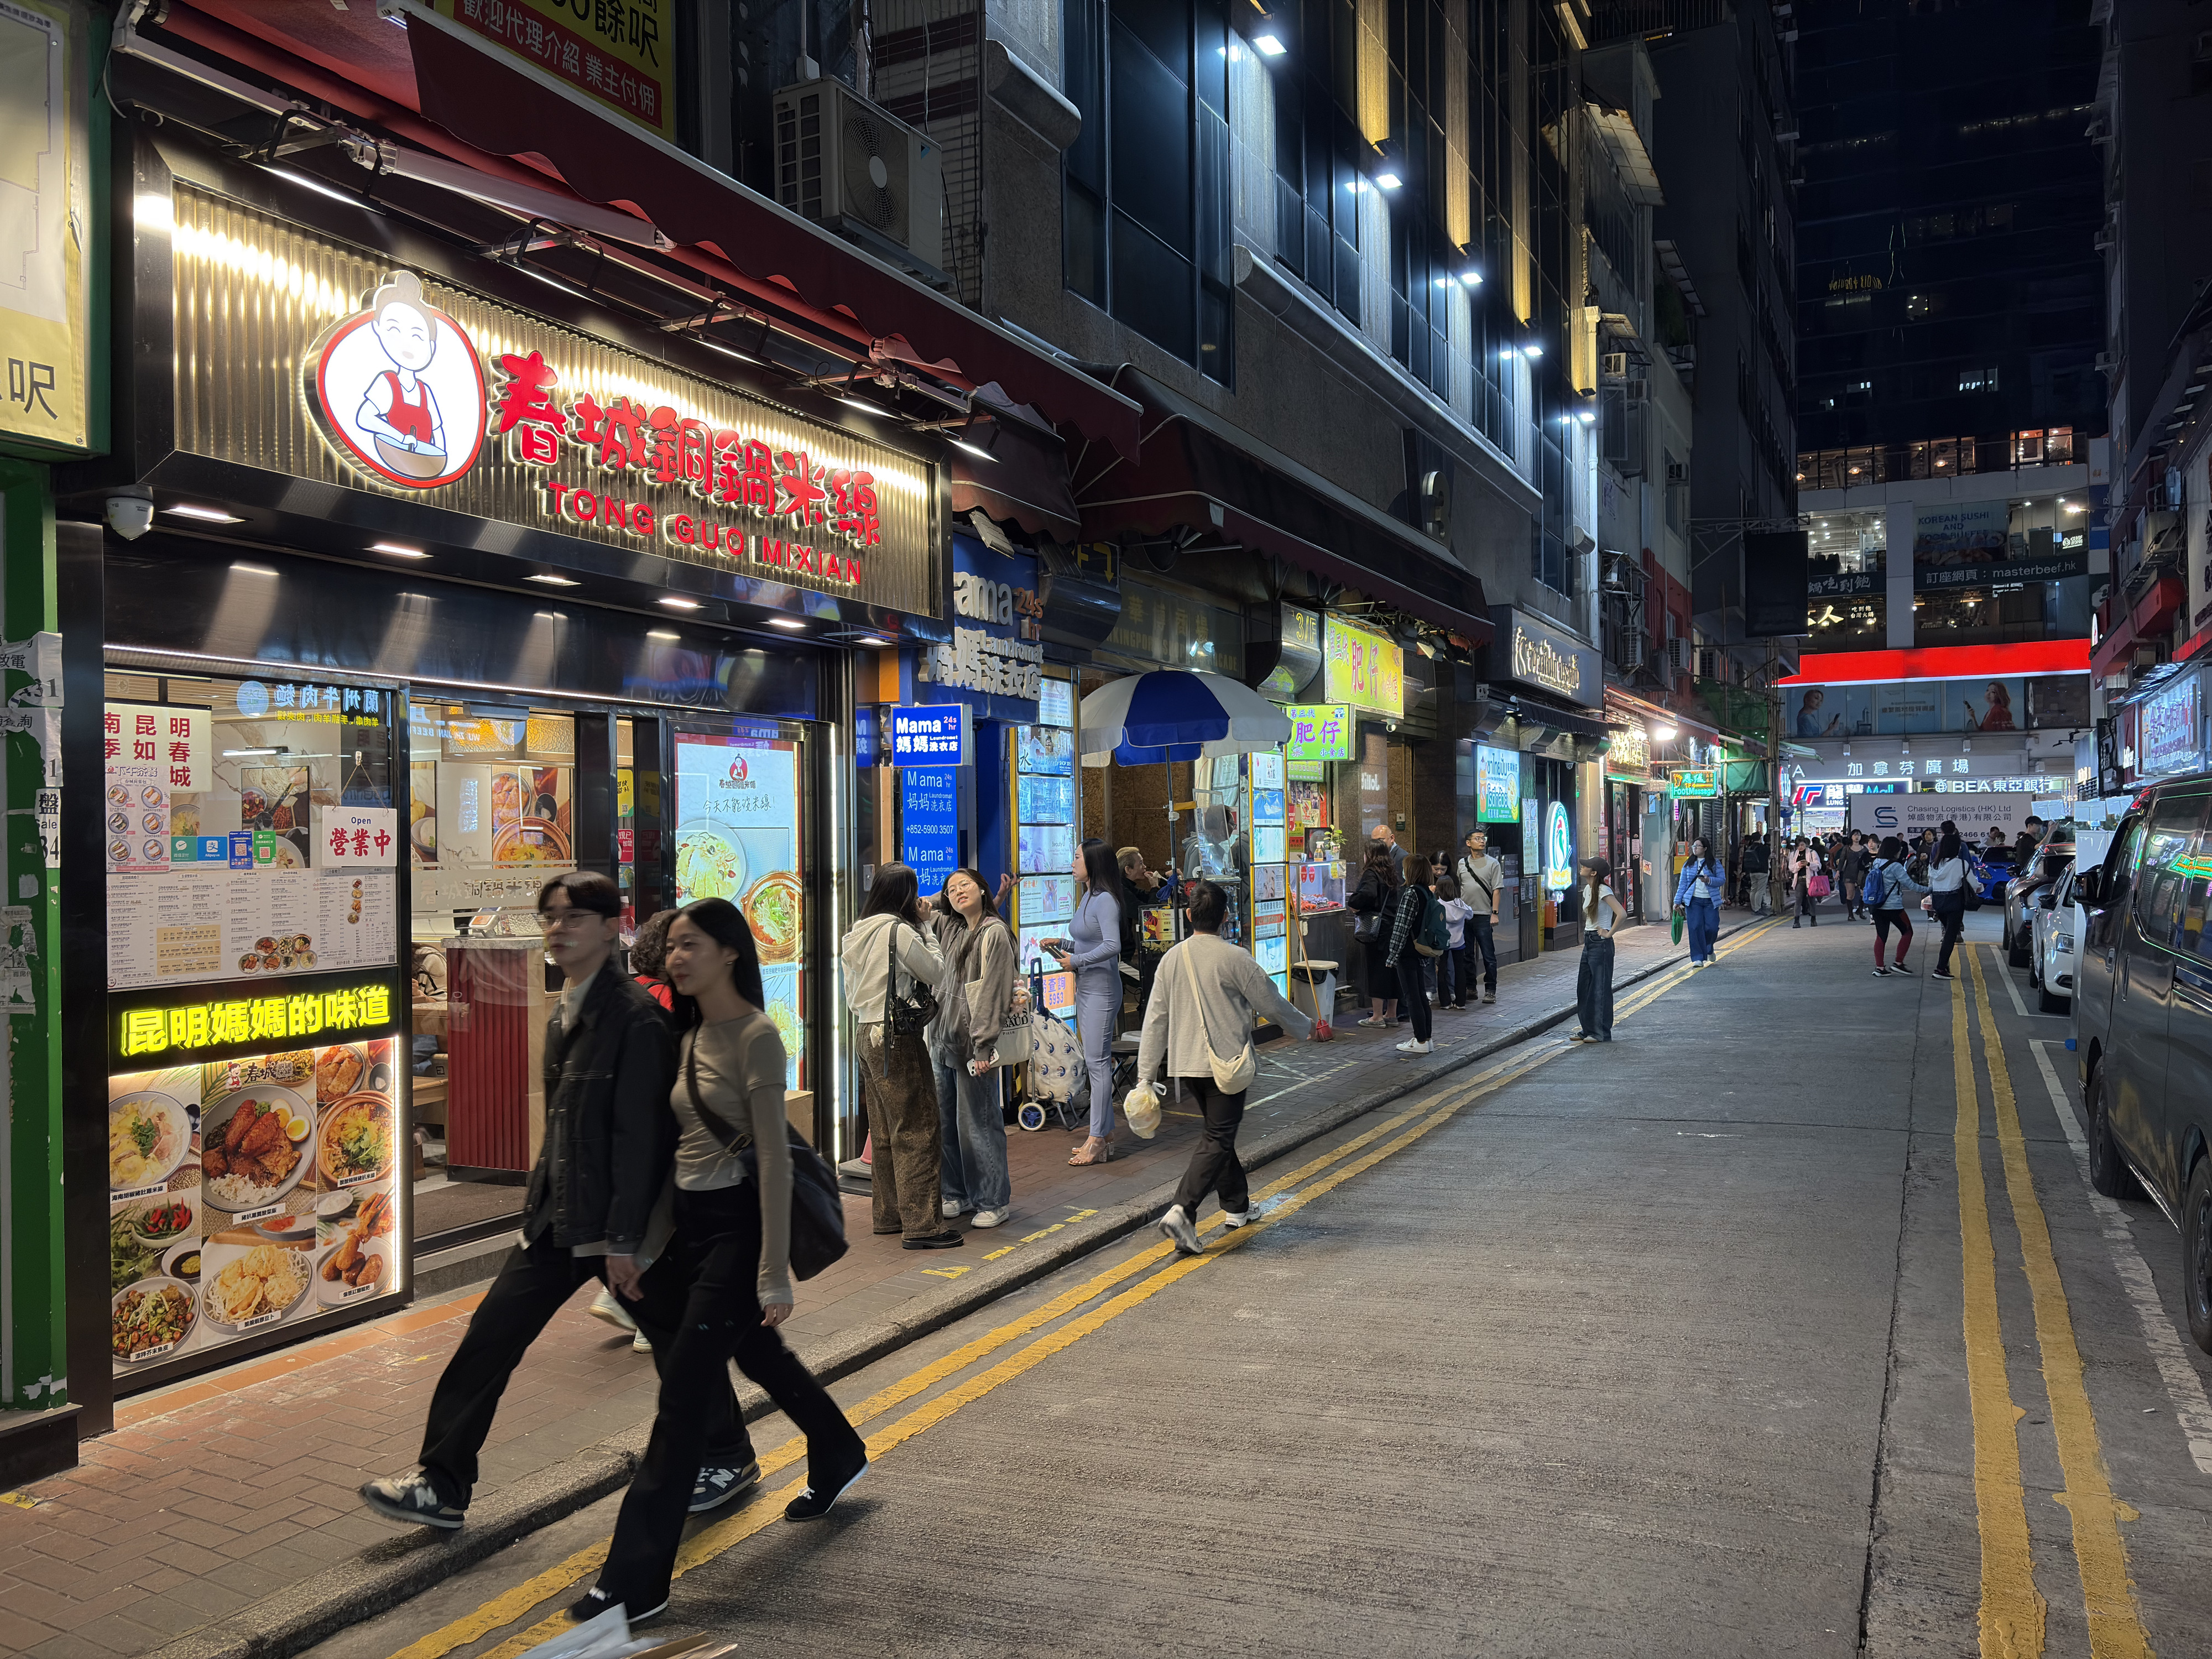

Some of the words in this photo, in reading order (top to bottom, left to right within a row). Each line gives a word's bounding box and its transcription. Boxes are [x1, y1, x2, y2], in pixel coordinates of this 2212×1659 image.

[465, 0, 580, 76] 歡迎代理介紹
[499, 351, 880, 545] 春城銅鍋米線
[1919, 514, 1958, 524] KOREAN
[1961, 512, 1989, 520] SUSHI
[547, 481, 654, 535] TONG
[675, 514, 744, 556] GUO
[763, 536, 861, 585] MIXIAN
[1992, 561, 2076, 578] masterbeef.hk
[954, 572, 1013, 626] ama
[1296, 613, 1317, 644] 3/F
[980, 630, 1044, 664] Laundromat
[1351, 637, 1379, 702] 肥仔
[1290, 708, 1316, 718] 第三代
[896, 717, 941, 734] Mama
[1294, 720, 1342, 745] 肥仔
[1319, 748, 1345, 758] 小食店
[115, 766, 158, 777] 下午茶餐
[1953, 780, 1992, 792] BEA
[1994, 779, 2053, 793] 東亞銀行
[907, 792, 952, 812] 妈妈洗衣店
[1907, 805, 1939, 813] Chasing
[1941, 805, 1975, 813] Logistics
[36, 819, 58, 829] Sale
[351, 817, 371, 825] Open
[906, 825, 938, 834] +852-5900
[939, 825, 953, 834] 3507
[330, 828, 391, 857] 營業中
[125, 987, 390, 1055] 昆明媽媽的味道
[244, 1062, 276, 1083] 春城
